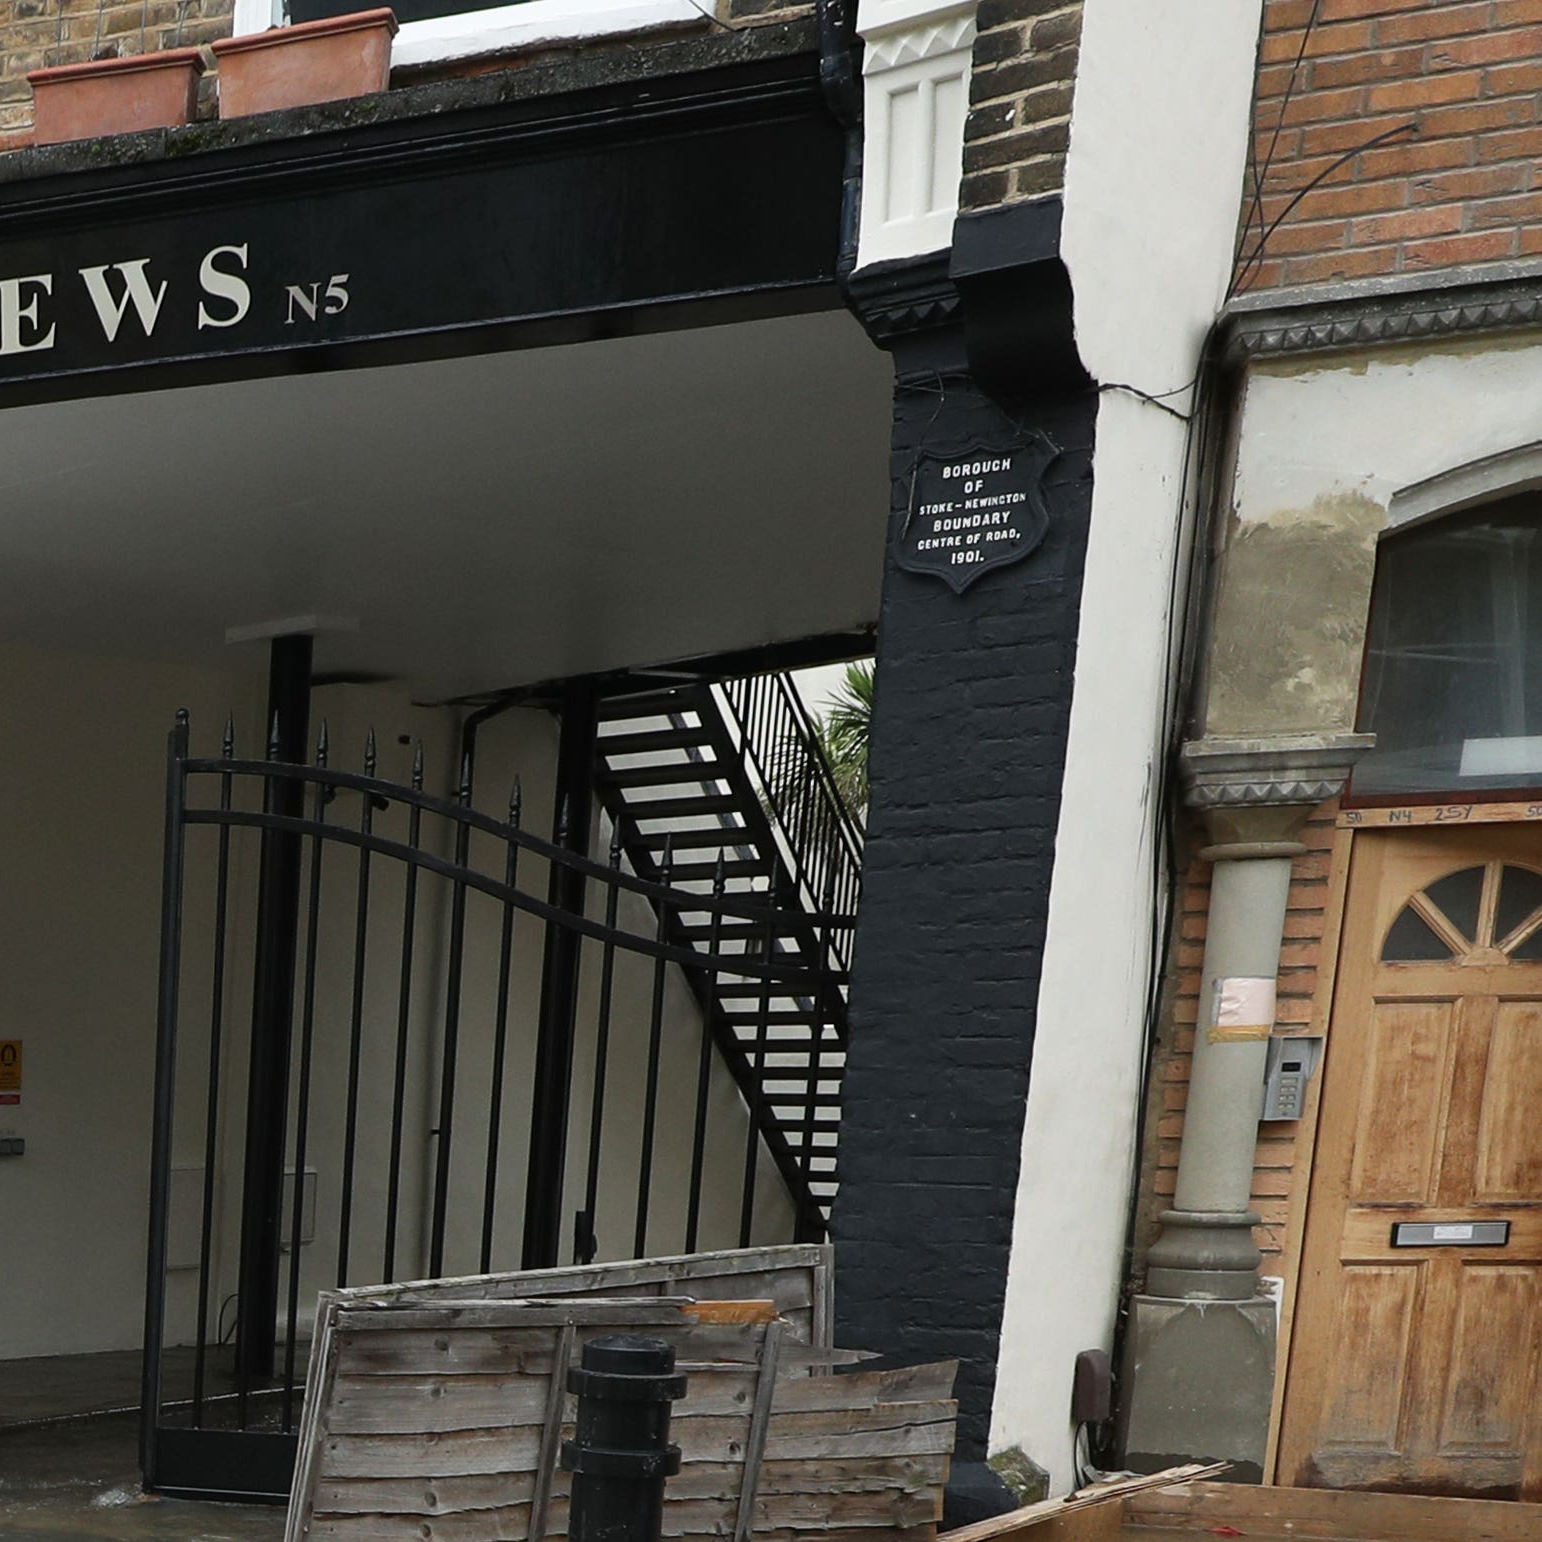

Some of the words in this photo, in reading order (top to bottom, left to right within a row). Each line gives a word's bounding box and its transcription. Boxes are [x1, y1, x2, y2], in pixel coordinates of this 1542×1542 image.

[284, 273, 351, 325] N5
[943, 458, 1011, 479] BOROUGH
[965, 480, 983, 493] OF
[933, 511, 1011, 532] BOUNDARY
[918, 536, 962, 551] CENTRE
[966, 533, 980, 544] OF
[951, 550, 985, 565] 1901.
[1389, 809, 1413, 823] N4
